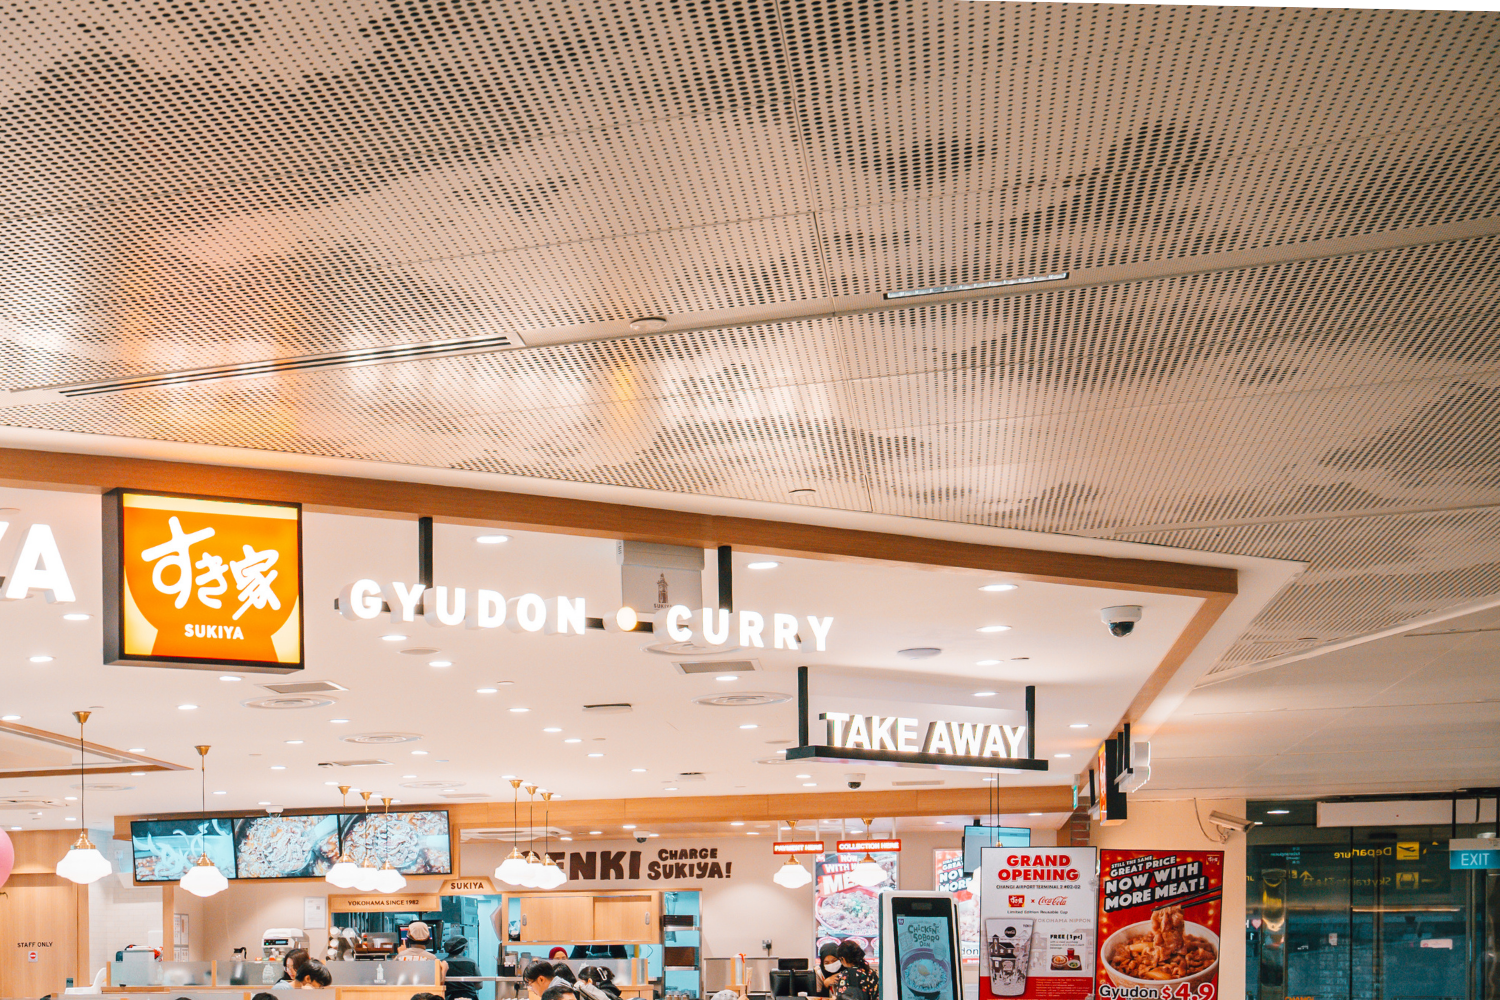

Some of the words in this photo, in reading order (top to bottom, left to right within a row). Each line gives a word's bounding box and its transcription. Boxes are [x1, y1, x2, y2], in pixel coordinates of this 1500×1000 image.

[141, 516, 281, 620] すき家
[349, 579, 587, 635] GYUDON
[666, 605, 834, 652] CURRY
[185, 623, 244, 640] SUKIYA
[823, 712, 918, 753] TAKE
[928, 719, 1026, 759] AWAY
[658, 849, 718, 861] CHARGE
[1007, 855, 1071, 867] GRAND
[1461, 853, 1490, 866] EXIT
[647, 861, 732, 880] SUKIYA!
[998, 869, 1079, 880] OPENING
[1110, 864, 1143, 877] GREAT
[1146, 856, 1176, 870] PRICE
[1106, 873, 1149, 894] NOW
[1154, 862, 1199, 883] WITH
[1105, 889, 1151, 911] MORE
[1155, 877, 1205, 900] MEAT!
[908, 925, 936, 934] CHICKEN
[913, 934, 940, 942] SOBORO
[1100, 985, 1158, 1000] Gyudon
